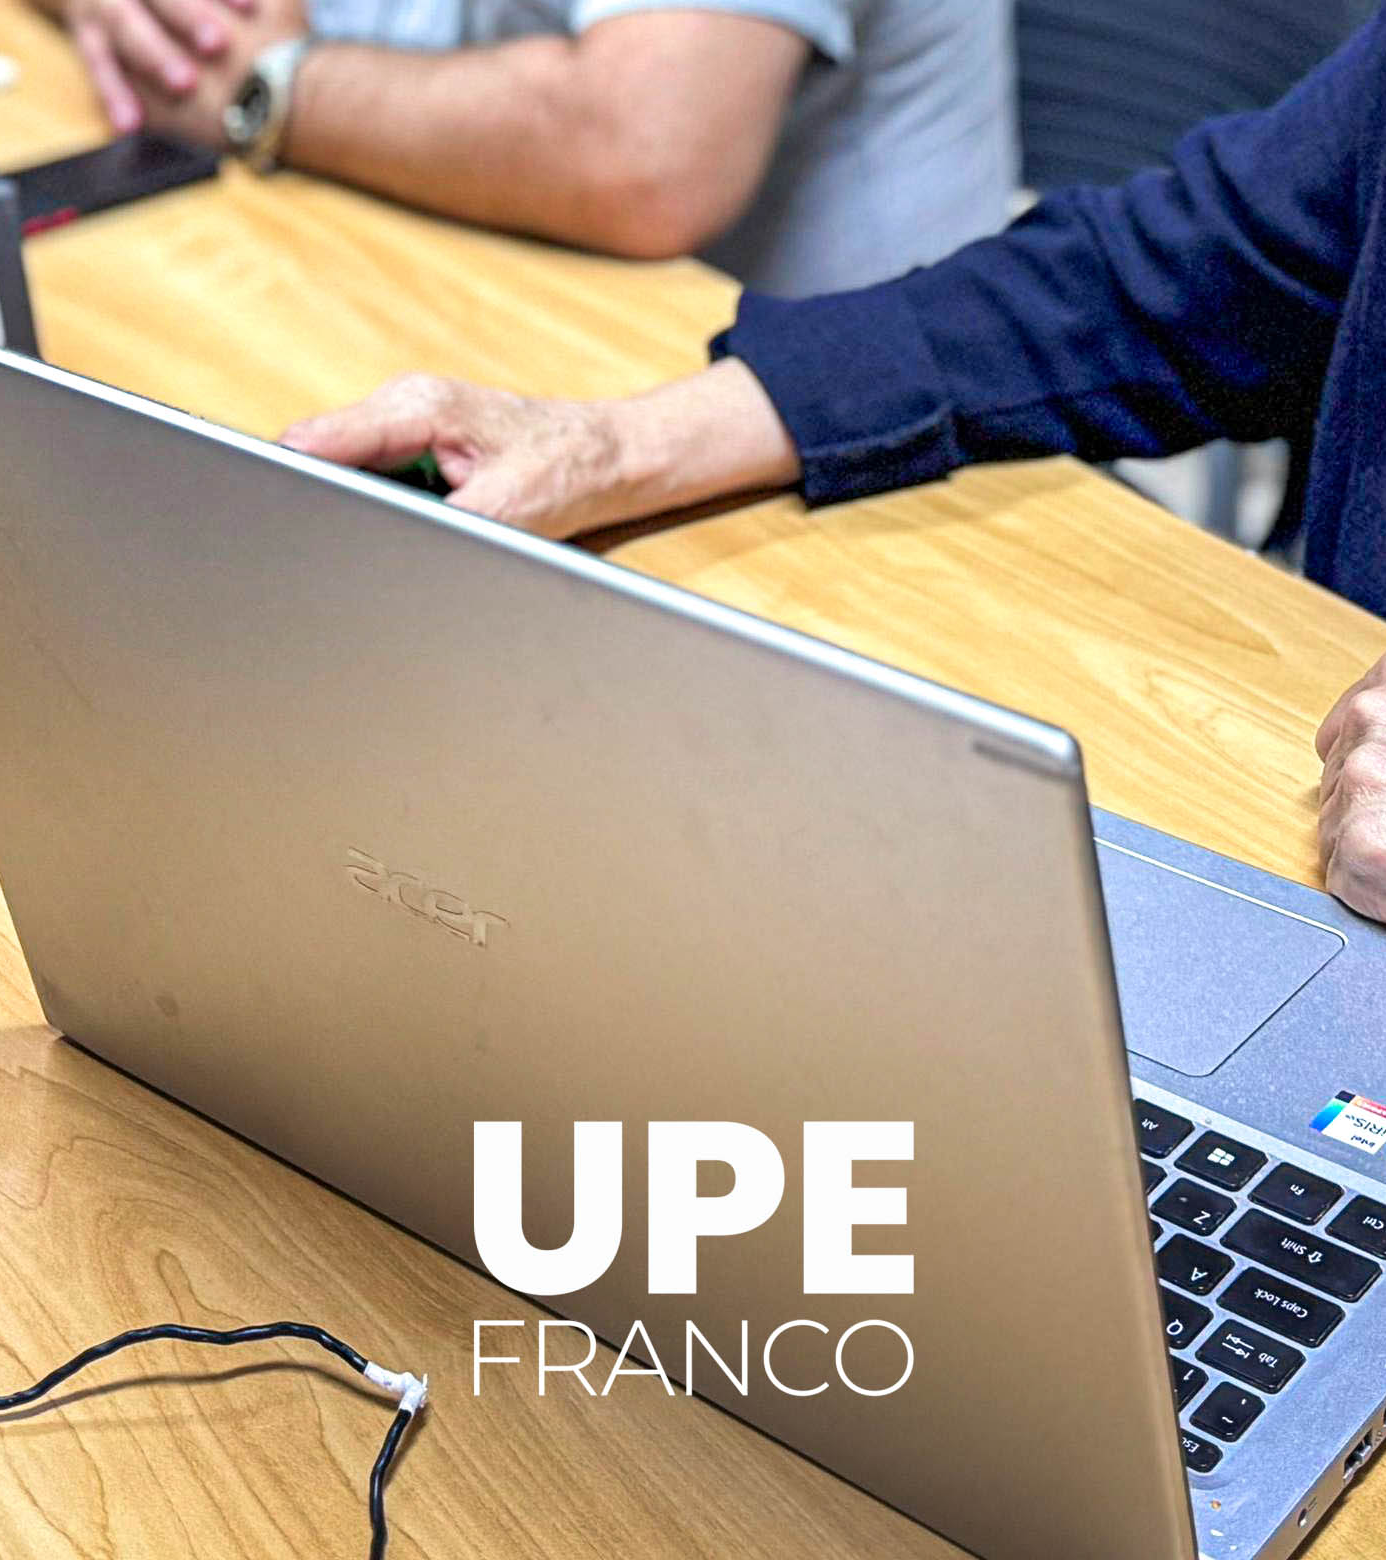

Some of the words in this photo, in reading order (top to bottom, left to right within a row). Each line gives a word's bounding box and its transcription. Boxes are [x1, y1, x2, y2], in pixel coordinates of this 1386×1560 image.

[1142, 1118, 1159, 1130] Alt
[1290, 1184, 1305, 1195] Fn
[1363, 1216, 1385, 1230] Ctrl
[1281, 1237, 1307, 1257] Shift
[1254, 1288, 1280, 1307] Lock
[1282, 1298, 1308, 1318] Caps
[1258, 1352, 1279, 1368] Tab
